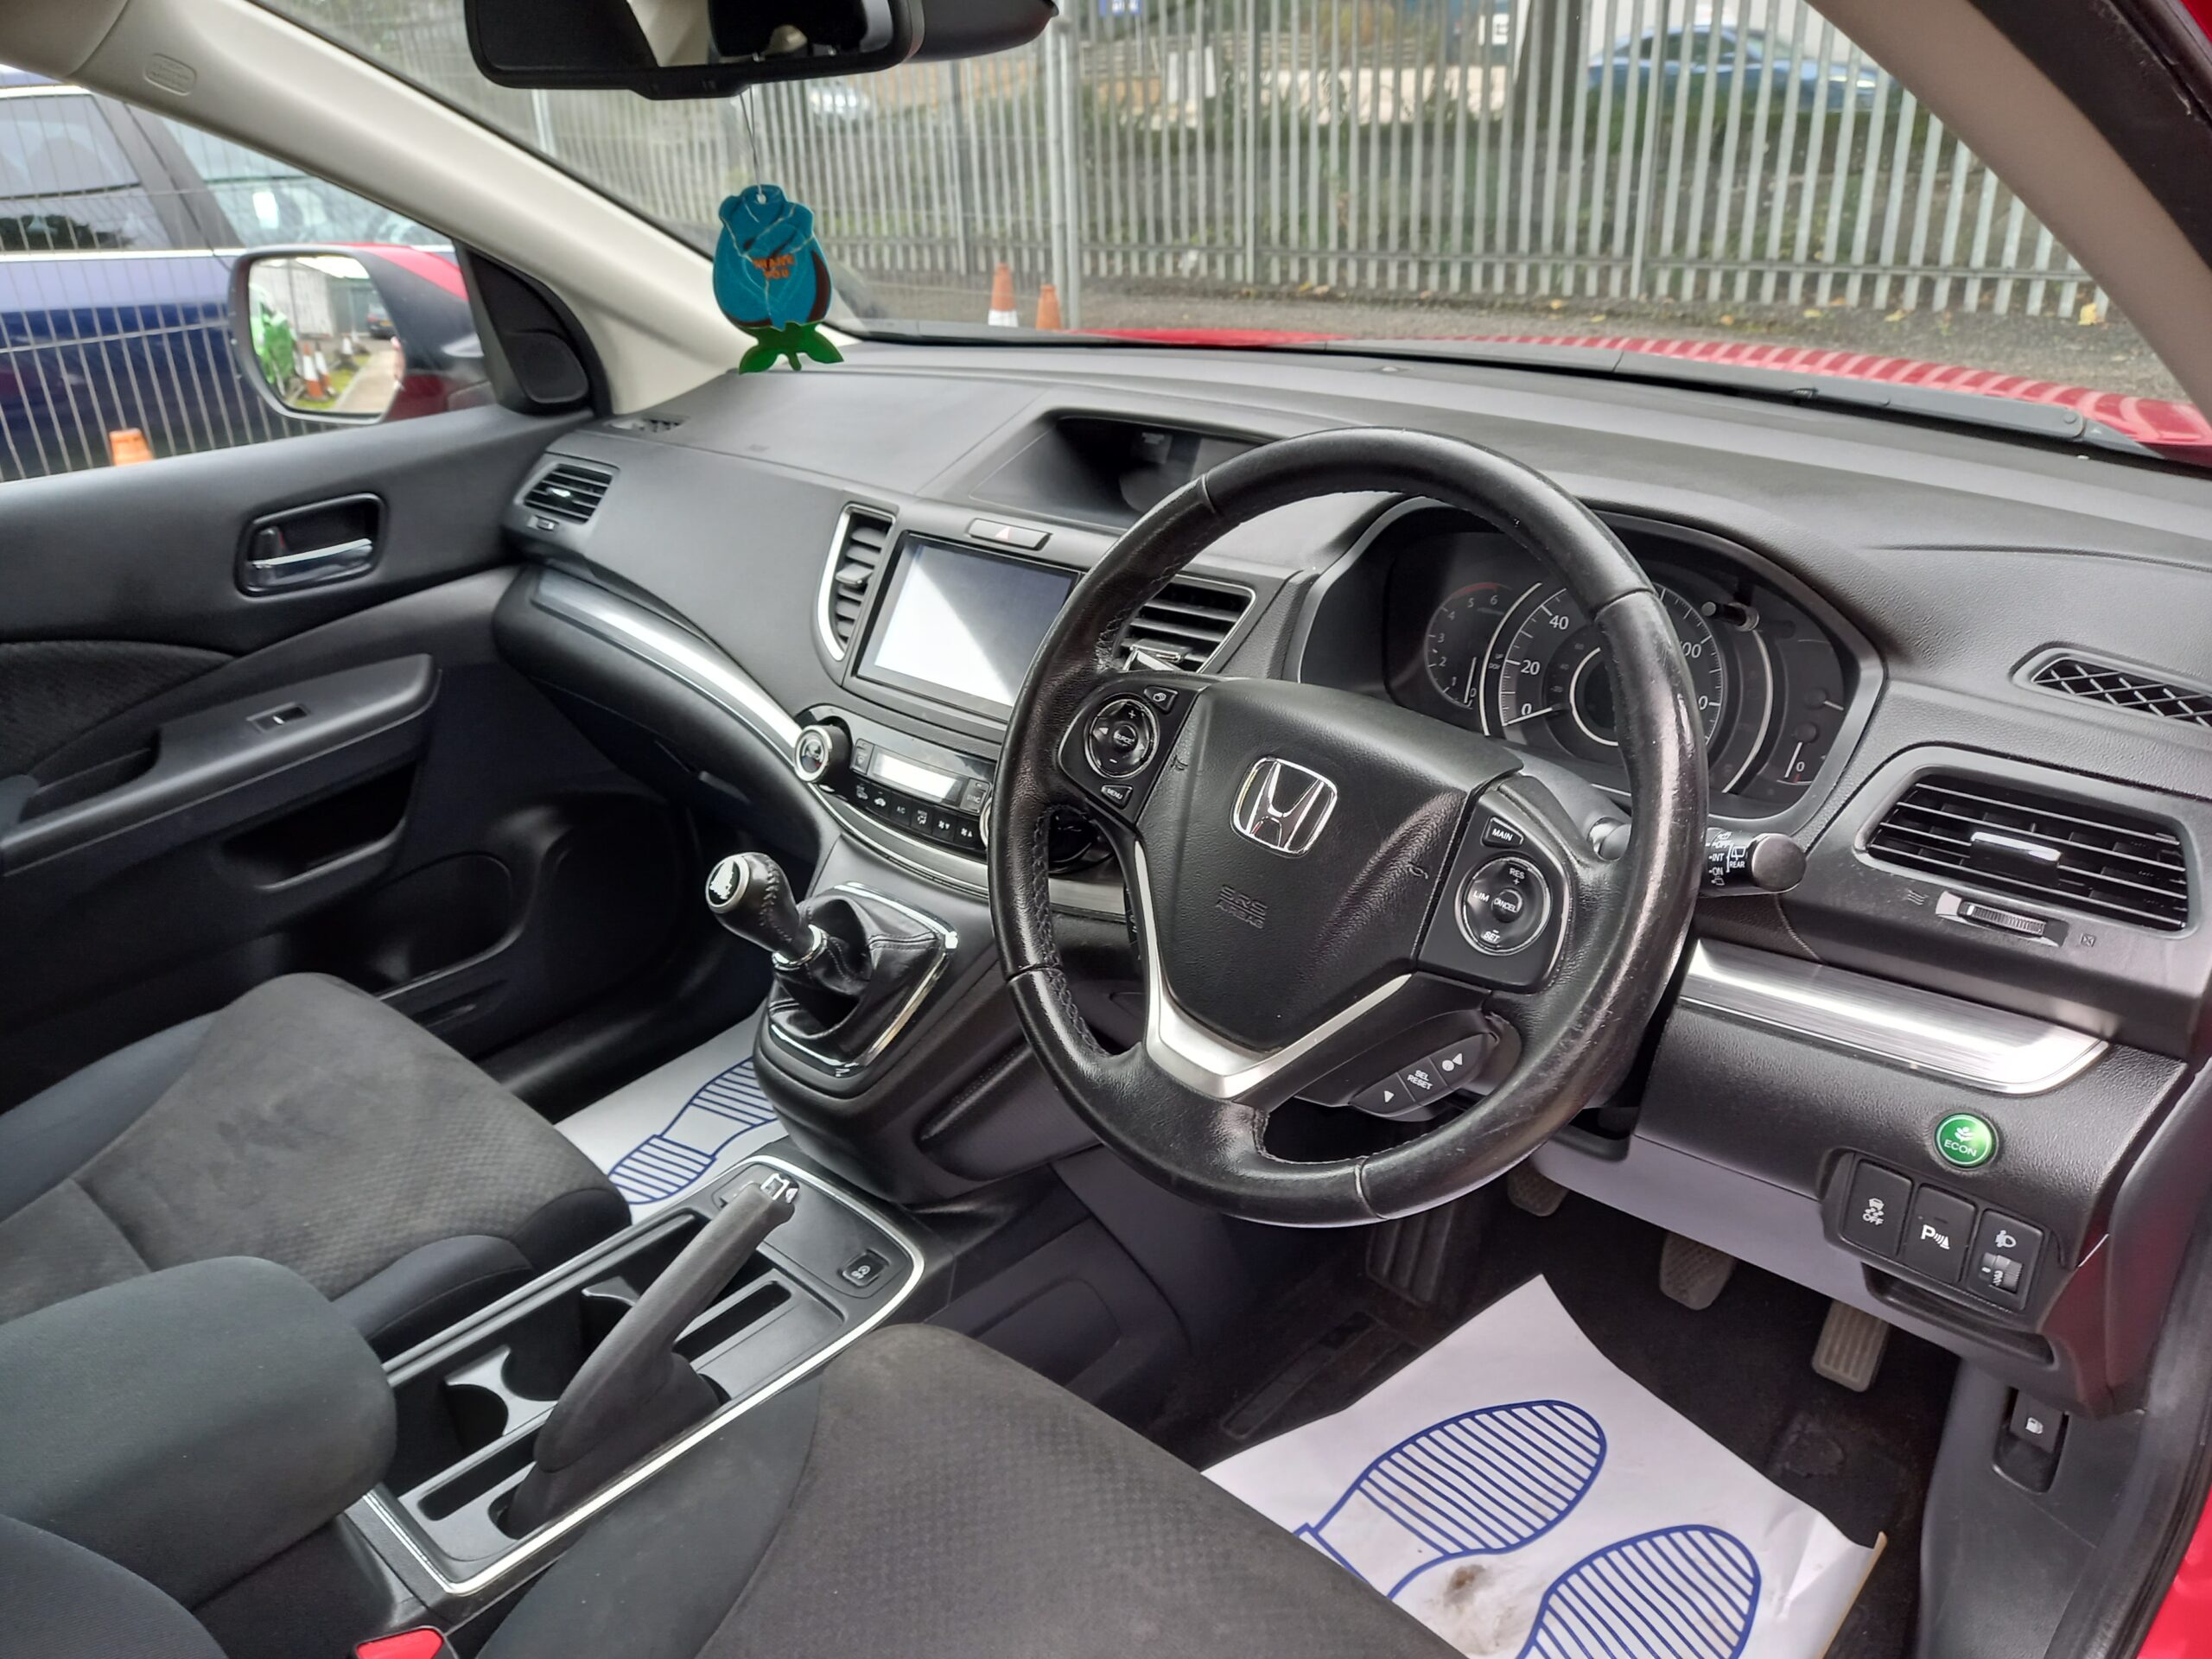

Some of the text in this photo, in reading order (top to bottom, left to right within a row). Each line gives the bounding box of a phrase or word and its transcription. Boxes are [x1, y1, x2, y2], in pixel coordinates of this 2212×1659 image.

[1467, 597, 1475, 607] 5
[1490, 594, 1498, 605] 6
[1447, 611, 1456, 620] 4
[1549, 614, 1569, 630] 40
[1438, 632, 1445, 643] 3
[1439, 657, 1446, 667] 2
[1521, 659, 1540, 675] 20
[1521, 702, 1532, 715] 0
[1796, 761, 1805, 772] 0
[1107, 788, 1123, 799] MENU
[1491, 828, 1513, 842] MAIN
[1712, 853, 1725, 861] INT
[1509, 868, 1525, 880] RES
[1712, 867, 1724, 876] ON
[1217, 884, 1268, 920] SRS
[1472, 890, 1490, 903] LIM
[1493, 898, 1516, 913] CANCEL
[1483, 931, 1501, 943] SET
[1414, 1070, 1429, 1081] SEL
[1407, 1074, 1433, 1090] RESET
[1943, 1138, 1977, 1157] ECON
[1862, 1212, 1885, 1225] OFF
[1920, 1224, 1936, 1240] P
